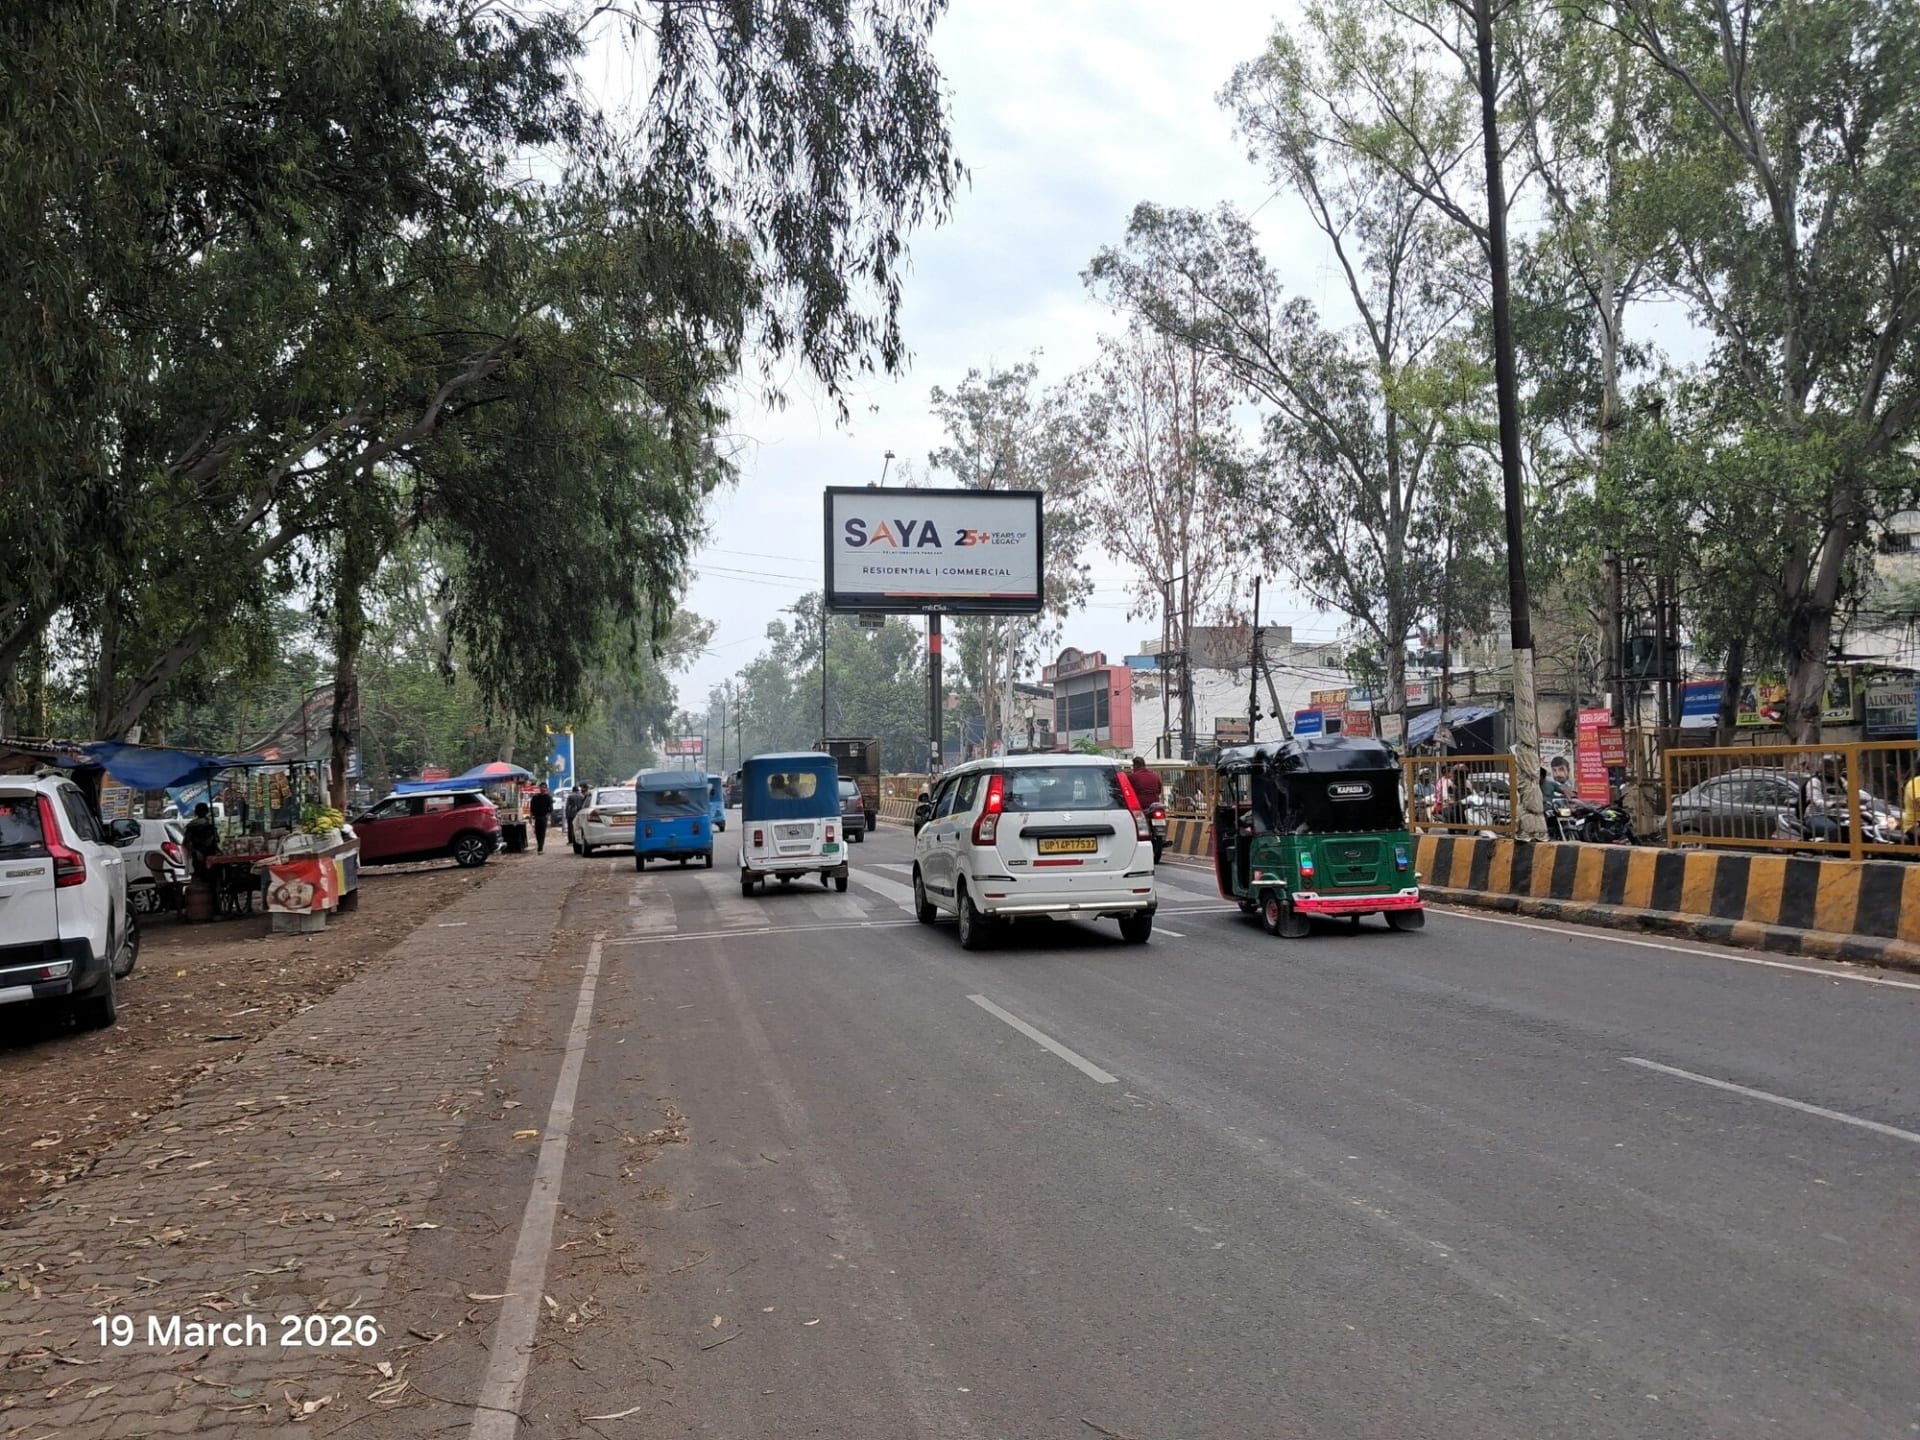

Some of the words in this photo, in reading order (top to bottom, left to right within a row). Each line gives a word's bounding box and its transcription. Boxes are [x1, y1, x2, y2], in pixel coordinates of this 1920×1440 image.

[844, 518, 942, 548] SAYA
[954, 529, 990, 546] 25+
[863, 567, 931, 575] RESIDENTIAL
[942, 568, 1012, 576] COMMERCIAL
